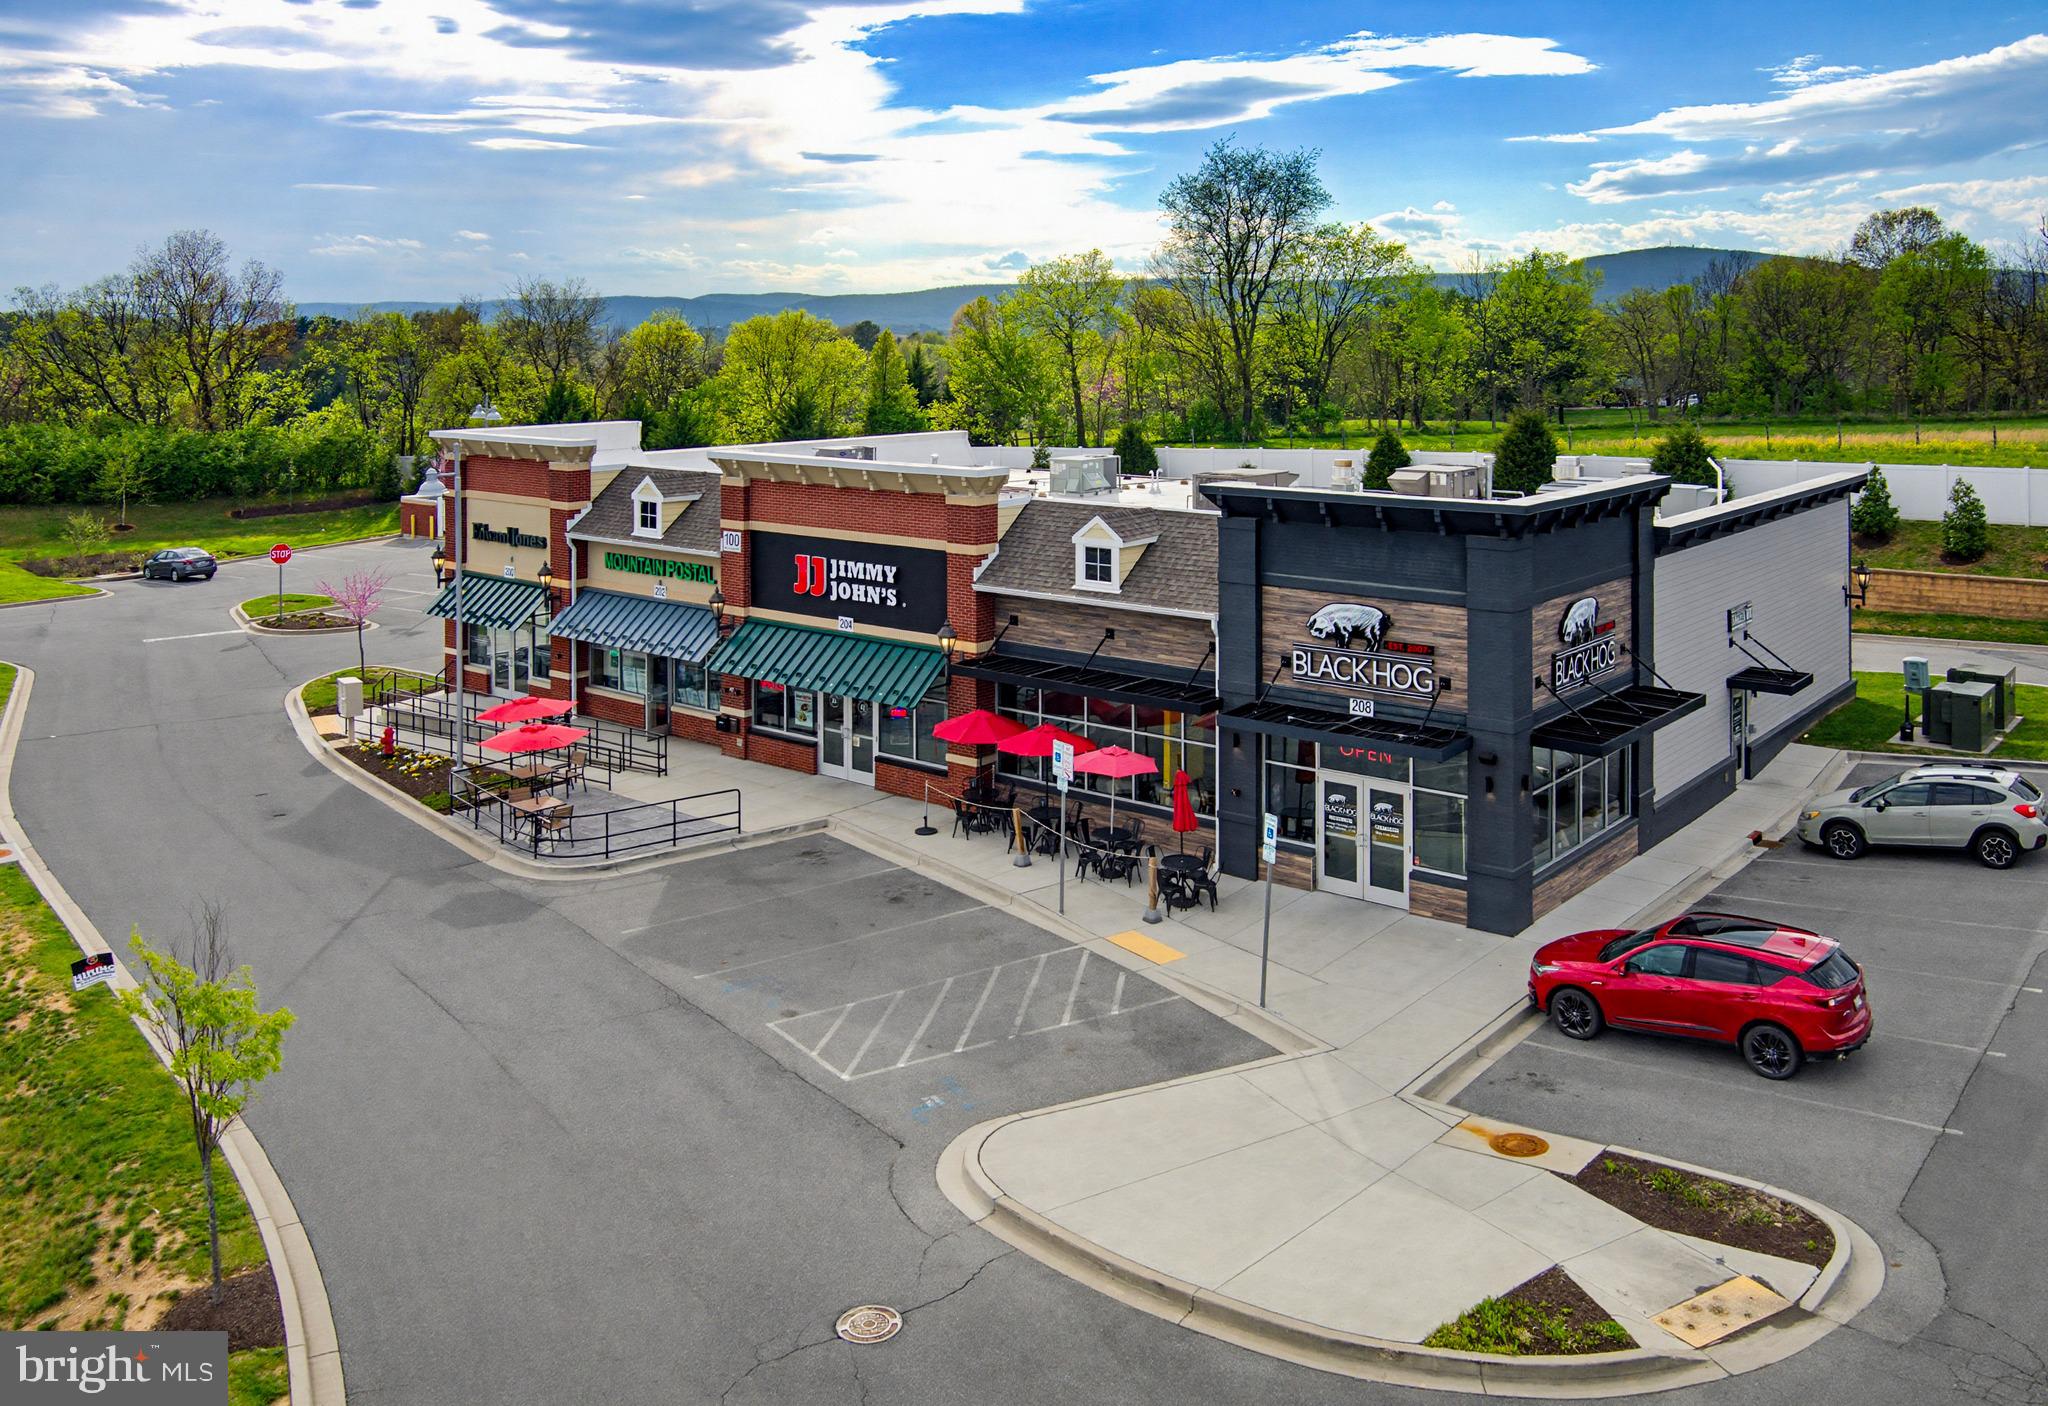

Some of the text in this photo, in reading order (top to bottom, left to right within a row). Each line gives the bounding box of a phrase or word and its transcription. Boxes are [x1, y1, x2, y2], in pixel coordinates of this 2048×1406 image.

[724, 532, 740, 547] 100
[271, 549, 291, 559] STOP
[604, 551, 716, 585] MOUNTAIN POSTAL
[793, 554, 828, 597] JJ
[829, 558, 897, 584] JIMMY
[829, 580, 897, 607] JOHN'S
[839, 618, 853, 630] 204
[1292, 650, 1434, 693] BLACK HOG
[1555, 640, 1616, 686] BLACK HOG
[1351, 699, 1372, 714] 208
[1370, 812, 1390, 823] BLACK
